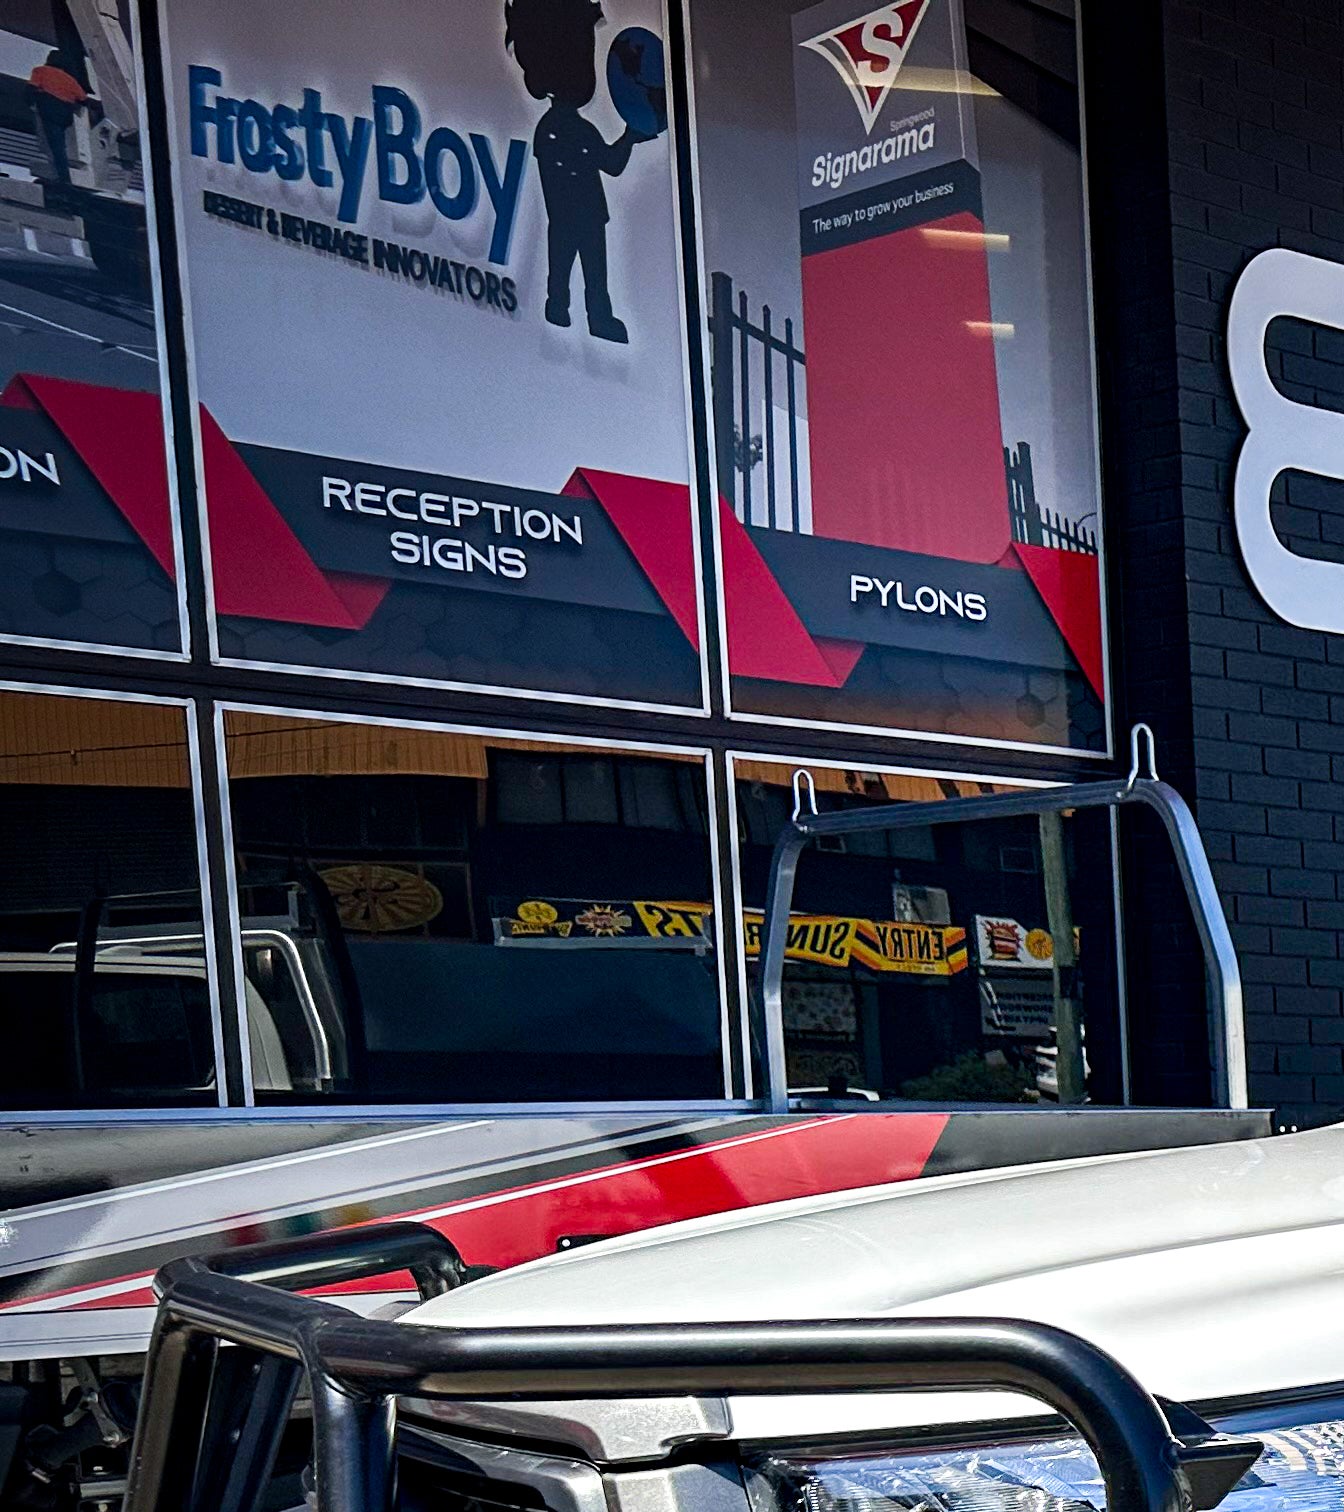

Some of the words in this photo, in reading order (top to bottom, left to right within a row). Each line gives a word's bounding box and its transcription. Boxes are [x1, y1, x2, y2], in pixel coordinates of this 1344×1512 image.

[811, 123, 935, 189] Signarama
[812, 218, 832, 234] The
[833, 211, 853, 228] way
[855, 208, 866, 221] to
[867, 201, 891, 219] grow
[892, 193, 914, 213] your
[915, 182, 954, 203] business
[266, 208, 281, 235] &
[280, 212, 369, 264] BEVERAGE
[372, 238, 518, 312] INNOVATORS
[322, 476, 583, 546] RECEPTION
[390, 531, 528, 580] SIGNS
[850, 575, 989, 622] PYLONS
